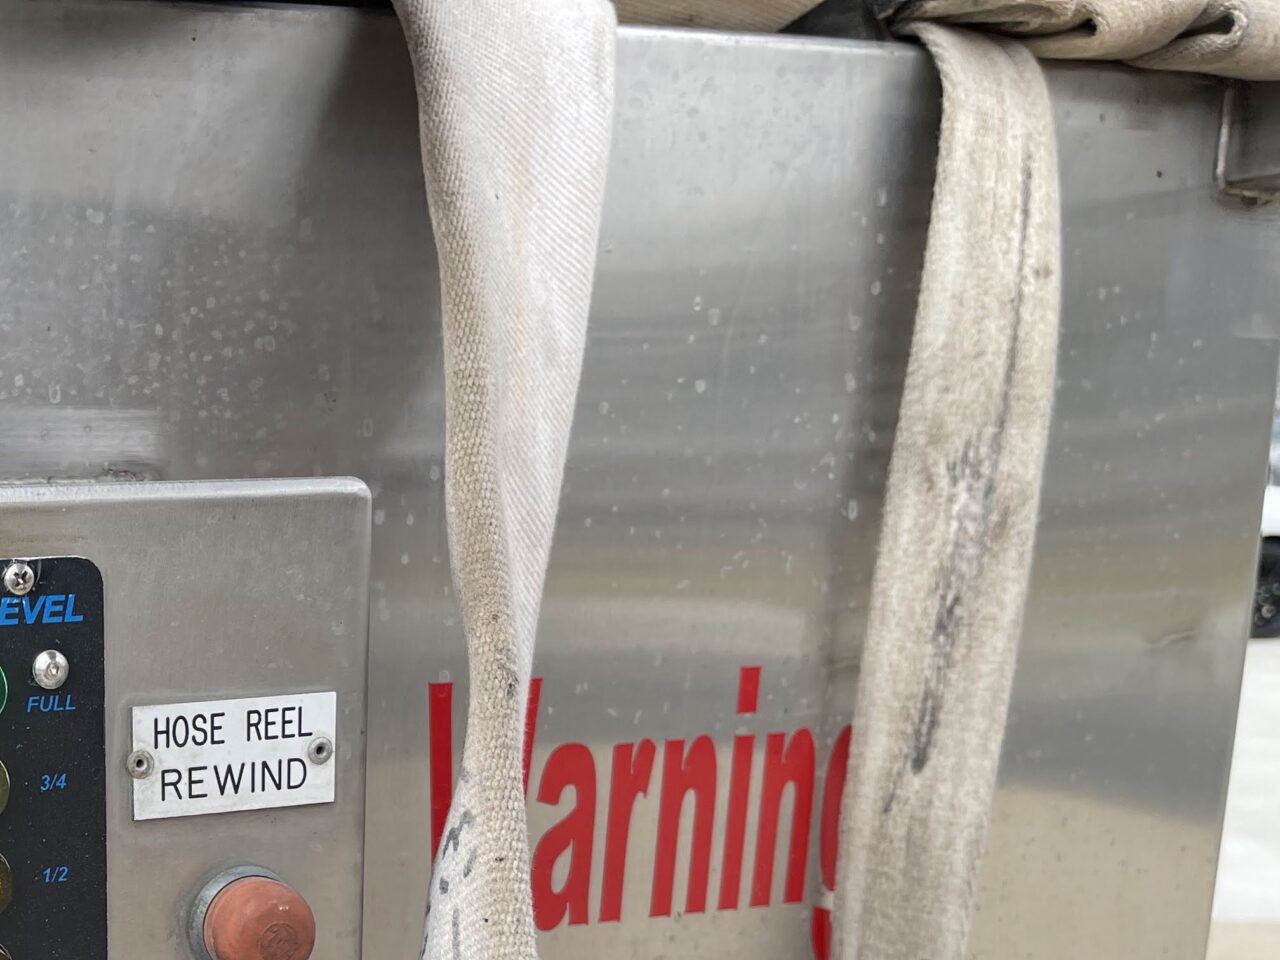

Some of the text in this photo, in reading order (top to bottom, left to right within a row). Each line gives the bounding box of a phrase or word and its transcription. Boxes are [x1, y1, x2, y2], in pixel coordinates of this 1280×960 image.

[26, 695, 76, 712] FULL
[153, 706, 313, 749] HOSE REEL
[40, 773, 67, 791] 3/4
[160, 757, 308, 801] REWIND
[42, 866, 69, 883] 1/2
